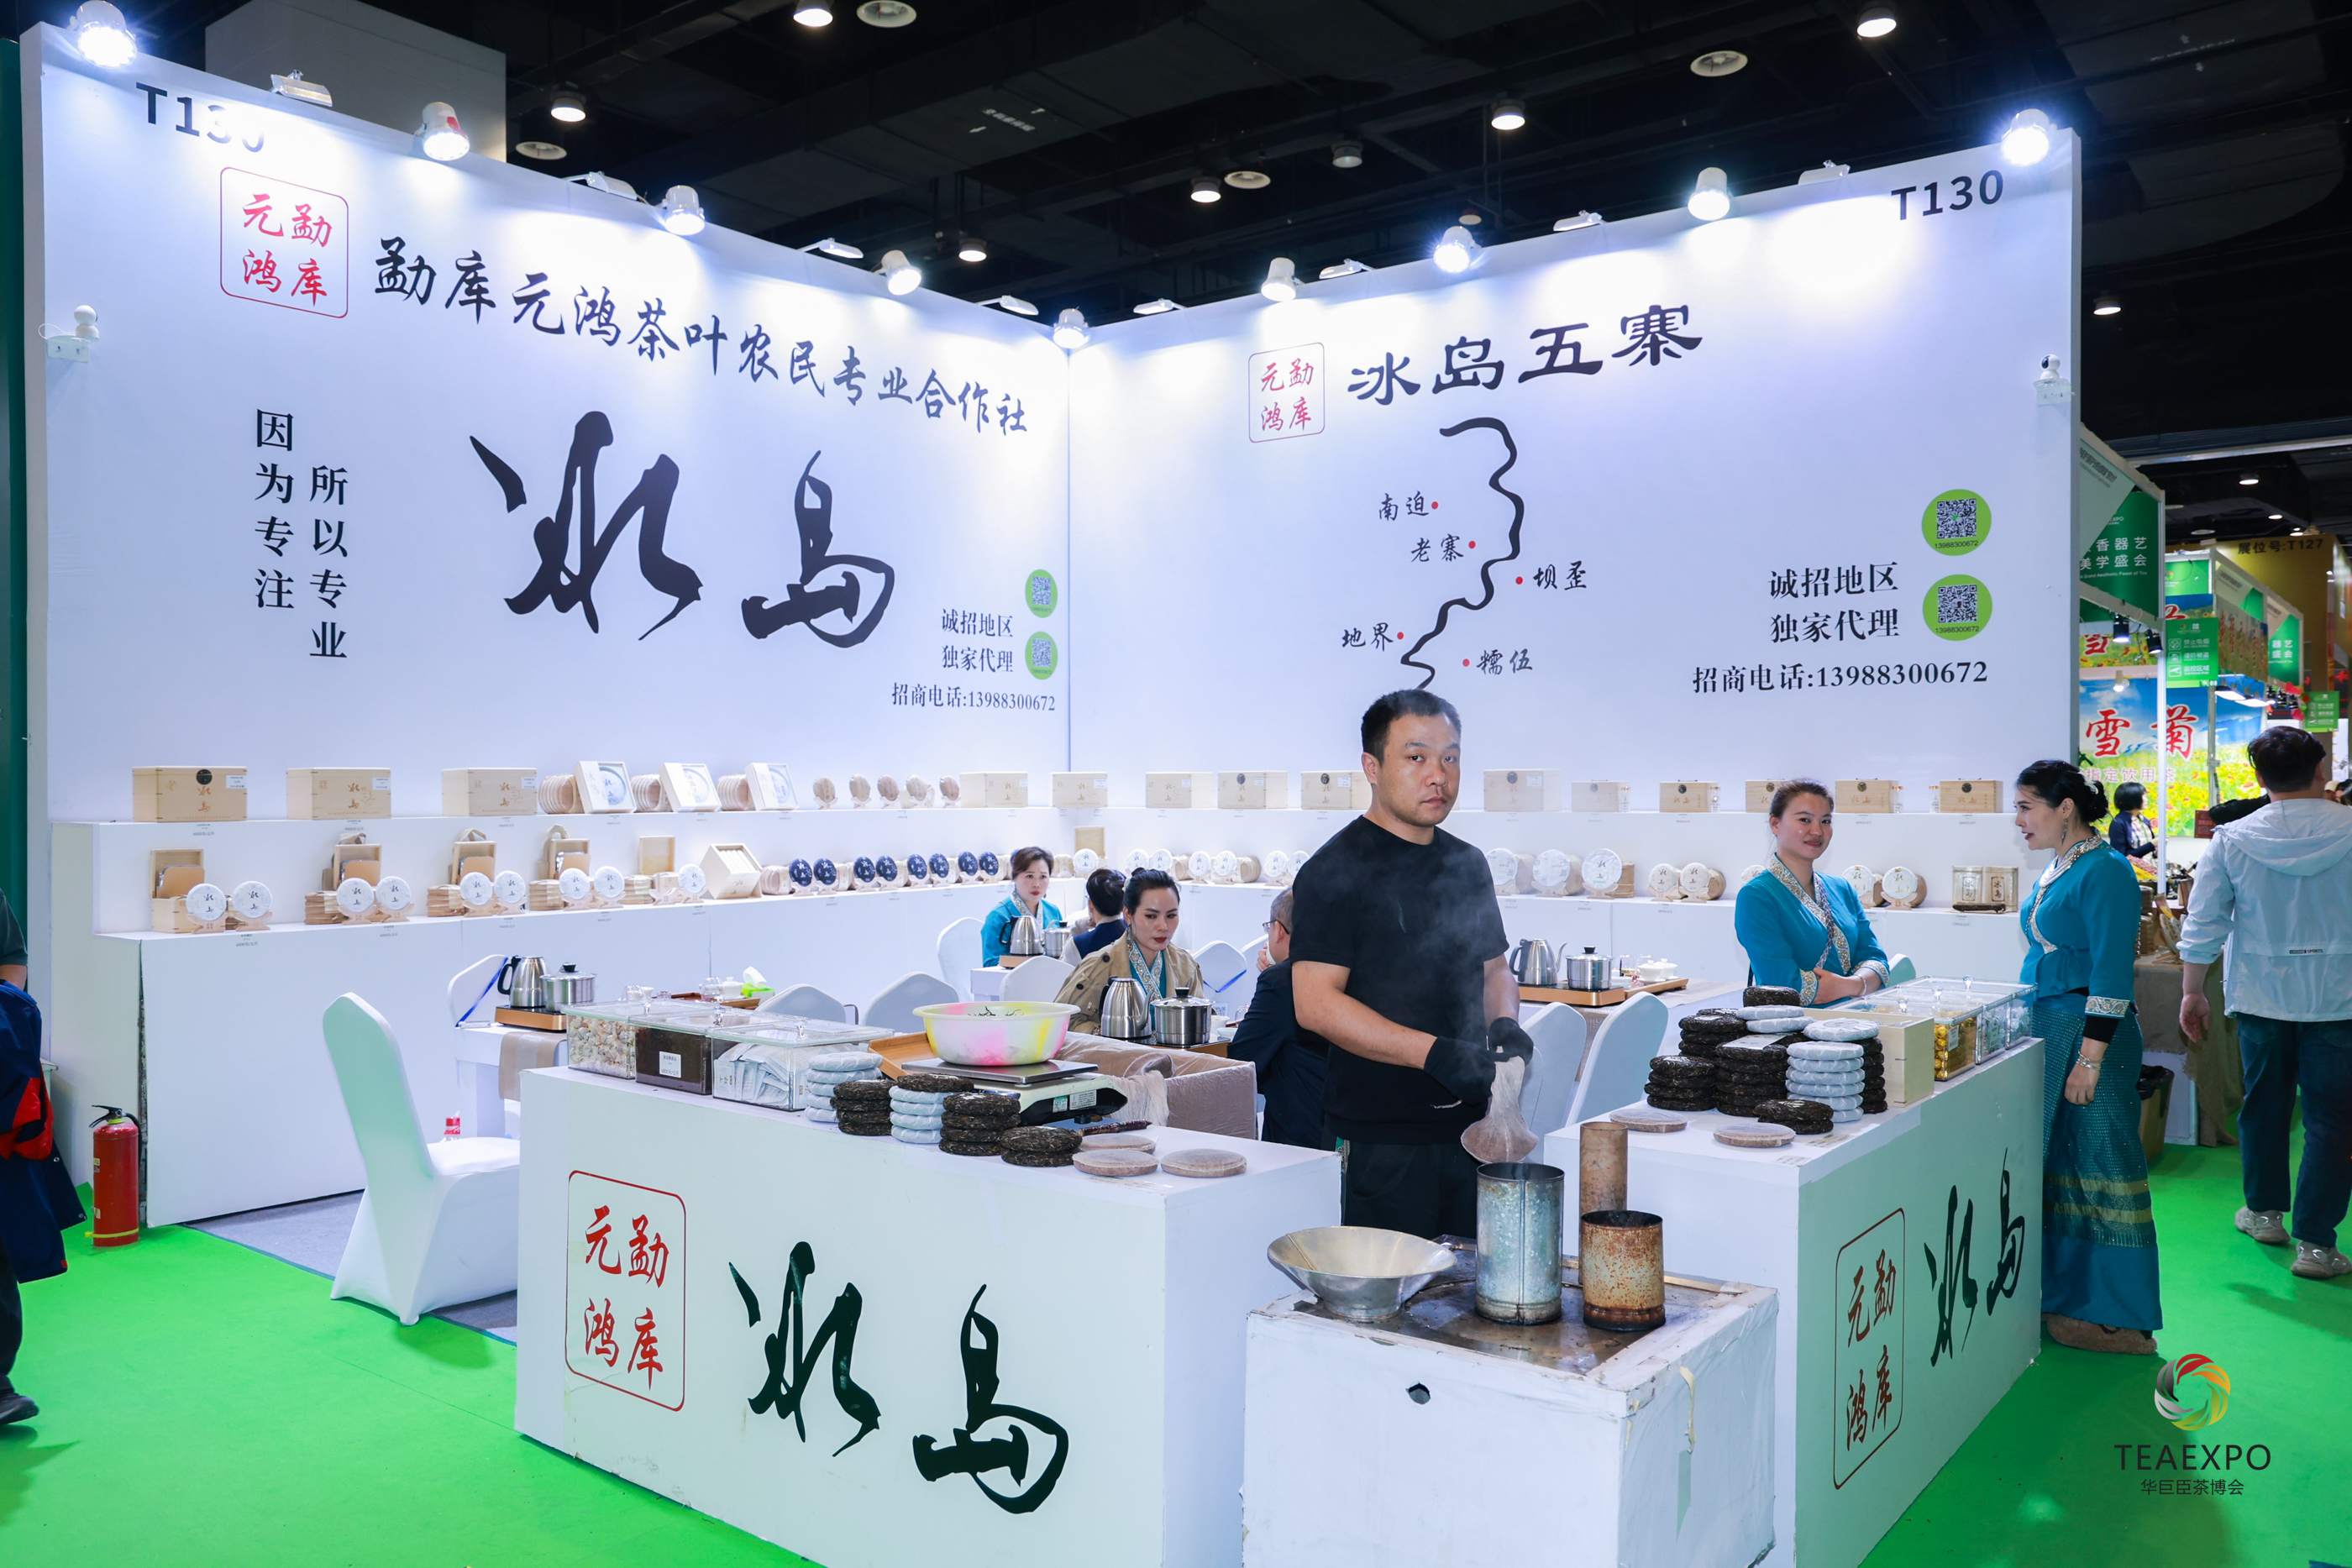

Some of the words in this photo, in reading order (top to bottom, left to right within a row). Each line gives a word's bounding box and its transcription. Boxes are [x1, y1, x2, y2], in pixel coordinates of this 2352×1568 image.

[136, 81, 265, 152] T130
[1892, 170, 2003, 220] T130
[375, 237, 1027, 435] 勐库元鸿茶叶农民专业合作社
[1348, 305, 1703, 405] 冰岛五寨
[255, 409, 294, 609] 因为专注
[1378, 490, 1429, 522] 南迫
[1411, 534, 1464, 563] 老寨
[1935, 540, 1979, 549] 13988300672
[2088, 537, 2147, 552] 香器艺
[2238, 538, 2323, 555] 展位号:T127
[310, 465, 348, 658] 所以专业
[1532, 561, 1587, 590] 坝歪
[2080, 554, 2147, 570] 美学盛会
[1770, 562, 1898, 599] 诚招地区
[942, 609, 1013, 638] 诚招地区
[1341, 621, 1394, 652] 地界
[1772, 609, 1899, 643] 独家代理
[942, 645, 1013, 673] 独家代理
[1477, 648, 1533, 675] 糯伍
[1693, 661, 1987, 694] 招商电话:13988300672
[891, 682, 1056, 711] 招商电话:13988300672
[2086, 705, 2197, 759] 雪菊
